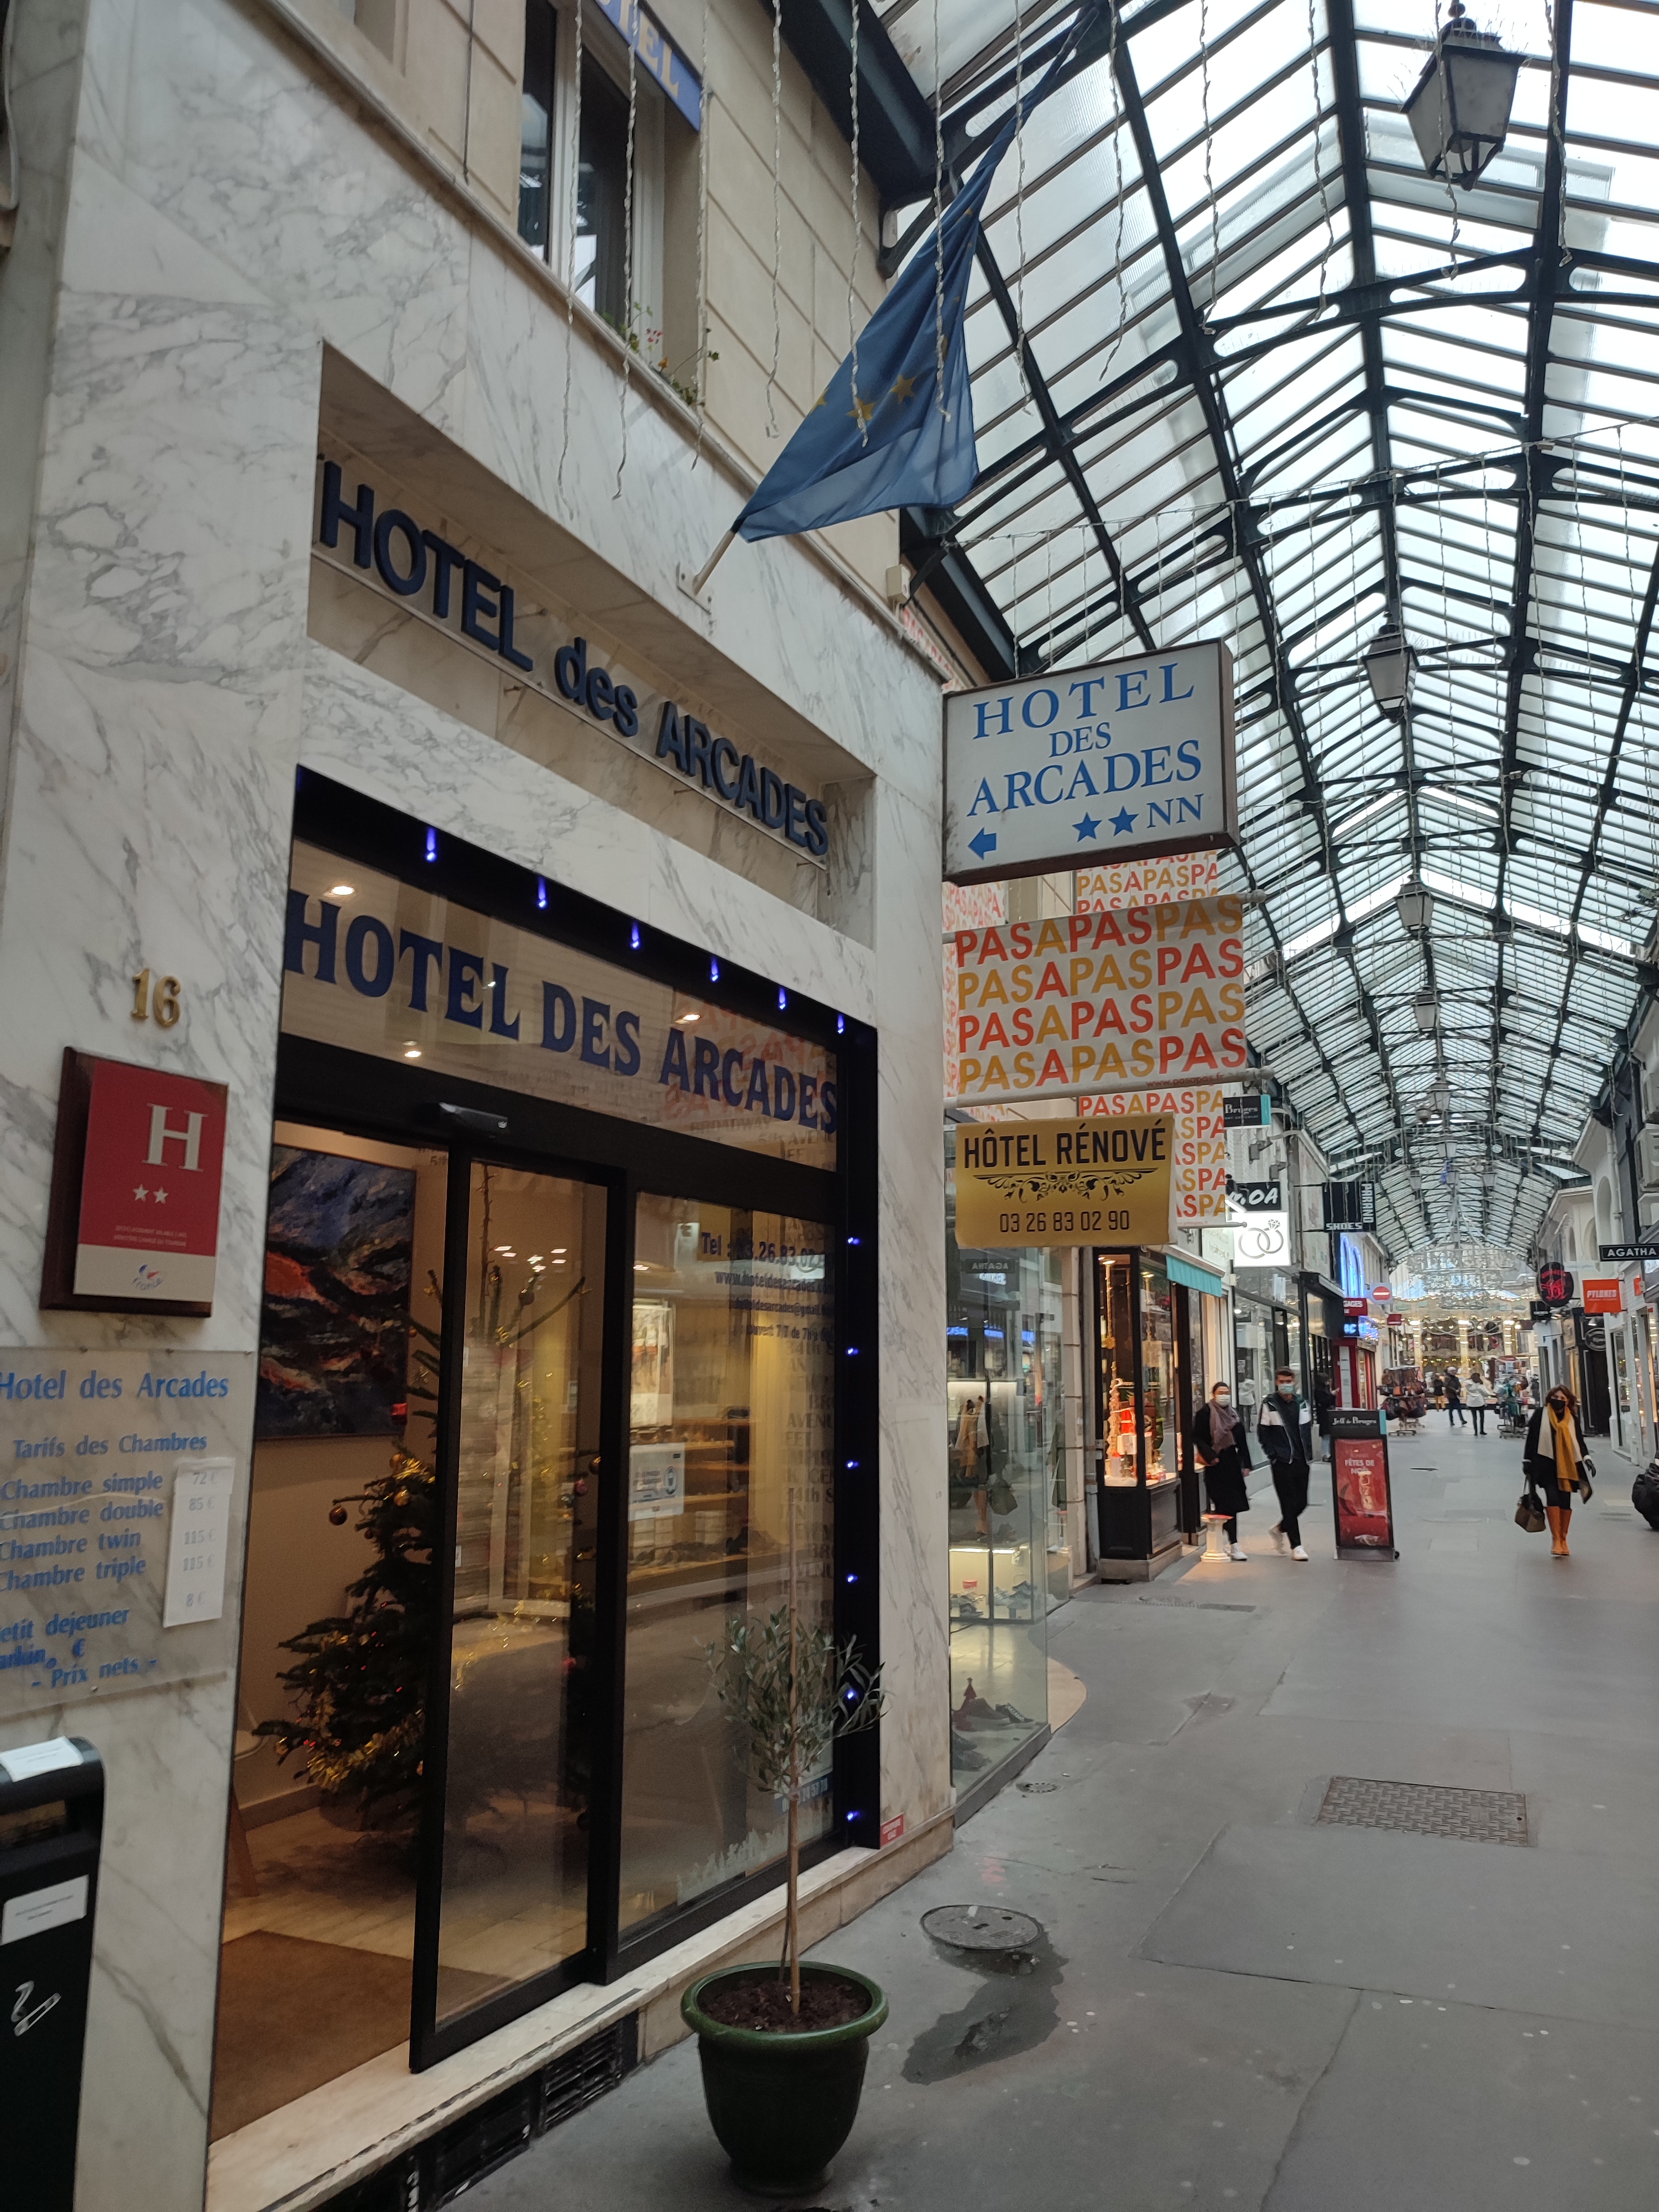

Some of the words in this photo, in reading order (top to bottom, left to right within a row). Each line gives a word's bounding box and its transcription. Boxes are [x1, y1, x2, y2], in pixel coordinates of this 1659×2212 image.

[319, 461, 533, 672] HOTEL
[555, 638, 639, 738] des
[656, 701, 828, 857] ARCADES
[973, 663, 1194, 739] HOTEL
[1048, 722, 1112, 758] DES
[967, 739, 1202, 817] ARCADES
[1146, 794, 1203, 828] NN
[131, 968, 181, 1027] 16
[285, 889, 520, 1041] HOTEL
[542, 980, 641, 1076] DES
[658, 1029, 838, 1134] ARCADES
[142, 1103, 208, 1172] H
[963, 1129, 1046, 1168] HÔTEL
[1056, 1119, 1166, 1163] RÉNOVÉ
[1000, 1213, 1020, 1232] 03
[1026, 1213, 1046, 1232] 26
[1053, 1212, 1073, 1231] 83
[1081, 1211, 1102, 1230] 02
[1108, 1210, 1129, 1230] 90
[1326, 1222, 1362, 1230] SHOES
[701, 1232, 722, 1255] Tel
[1607, 1248, 1657, 1257] AGATHA
[80, 1370, 123, 1399] des
[137, 1371, 229, 1399] Arcades
[14, 1436, 65, 1459] Tarifs
[76, 1435, 108, 1455] des
[119, 1432, 207, 1454] Chambres
[1, 1476, 92, 1500] Chambre
[103, 1470, 163, 1495] simple
[193, 1472, 207, 1485] 72
[0, 1506, 90, 1531] Chambre
[100, 1499, 164, 1521] double
[189, 1496, 203, 1511] 85
[0, 1535, 88, 1561] Chambre
[98, 1528, 141, 1551] twin
[184, 1529, 205, 1545] 115
[96, 1555, 147, 1583] triple
[183, 1556, 203, 1572] 115
[45, 1609, 130, 1638] dejeuner
[51, 1663, 88, 1688] Prix
[100, 1657, 138, 1678] nets
